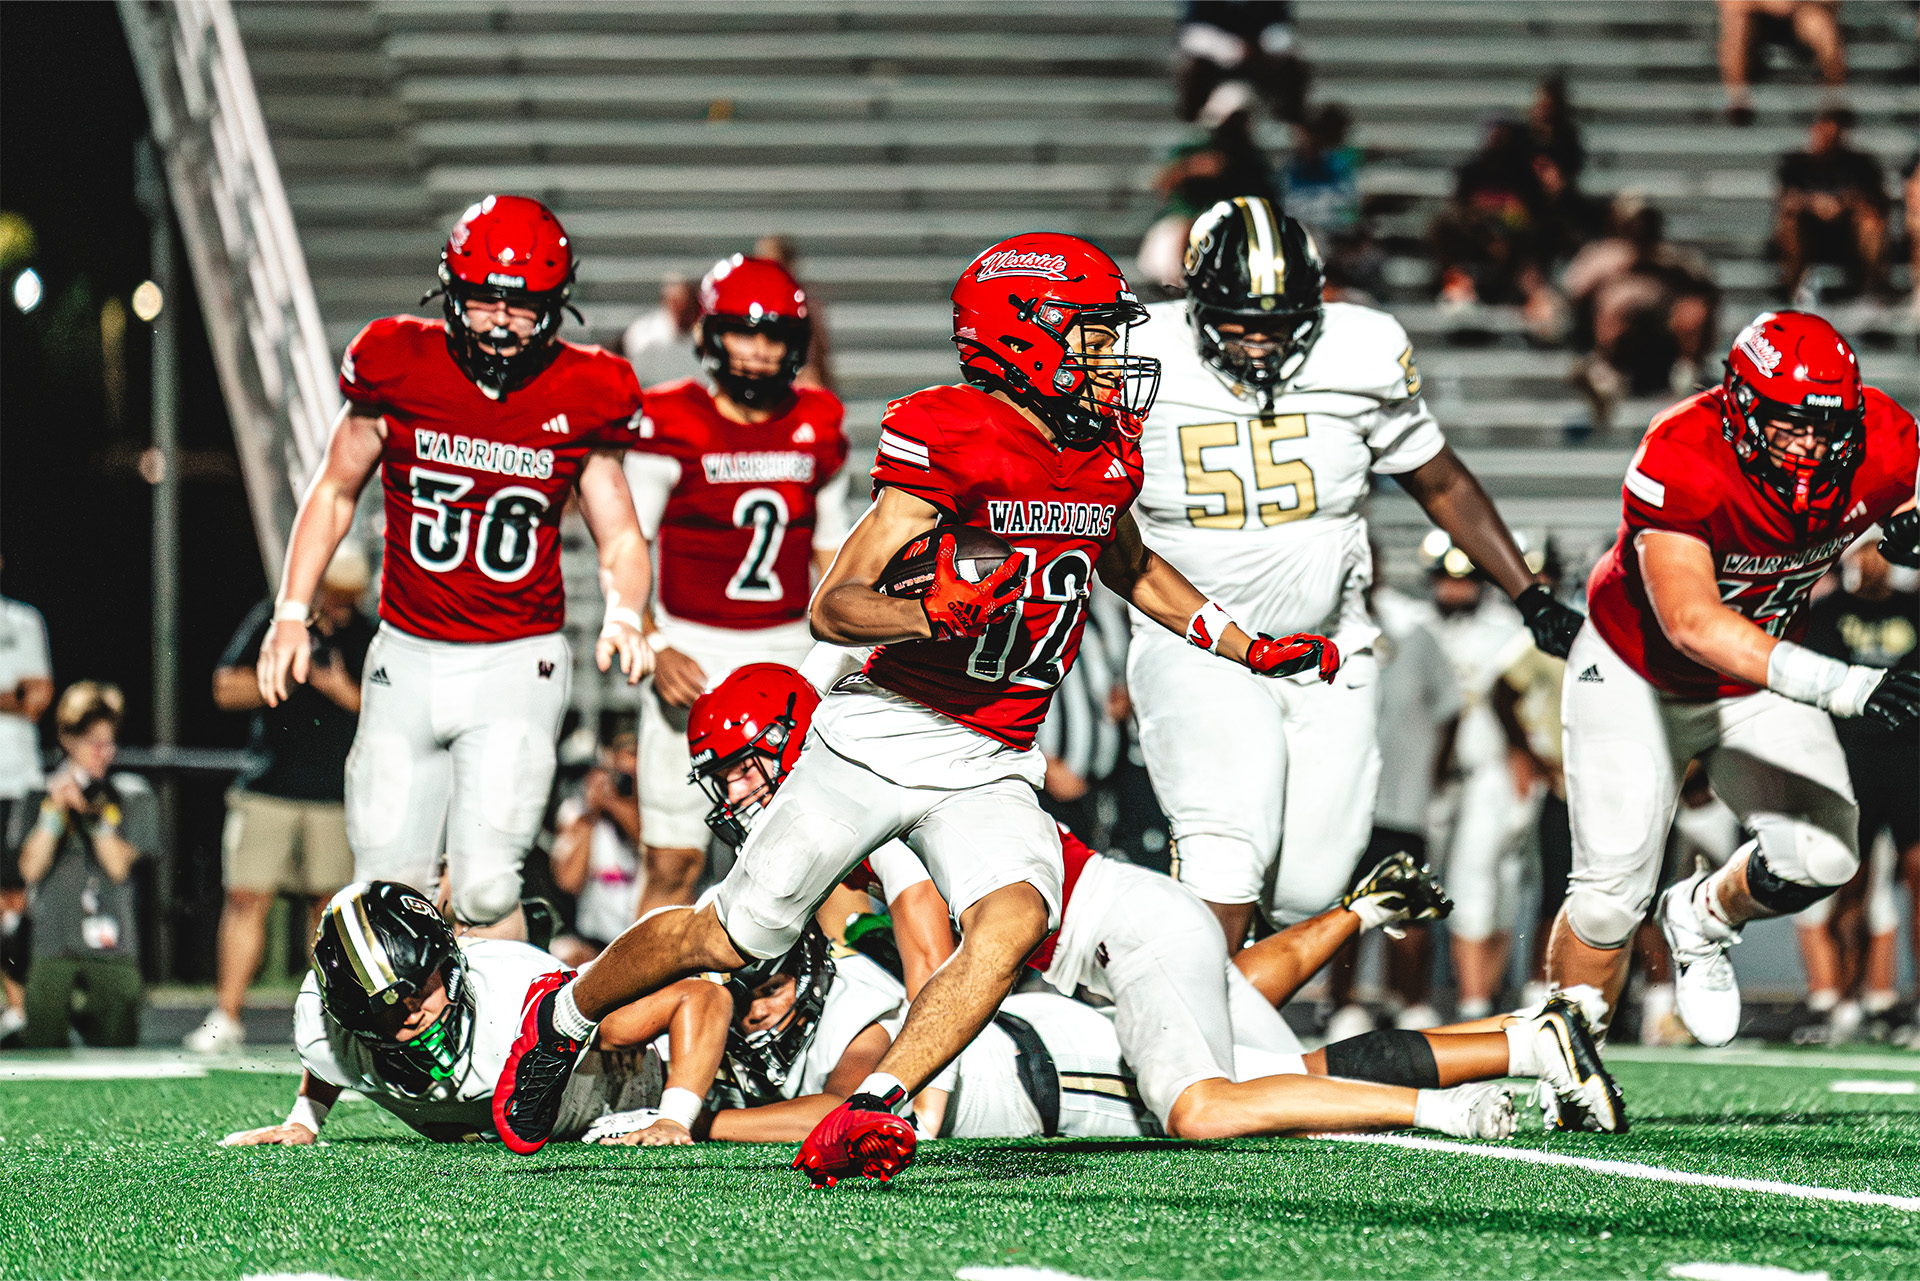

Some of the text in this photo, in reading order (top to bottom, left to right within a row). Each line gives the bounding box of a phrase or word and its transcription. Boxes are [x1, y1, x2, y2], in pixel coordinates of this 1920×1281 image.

[980, 249, 1068, 278] Westside
[415, 428, 556, 480] WARRIORS
[701, 451, 816, 484] WARRIORS
[1177, 414, 1318, 530] 55
[988, 501, 1116, 536] WARRIORS
[725, 487, 789, 602] 2
